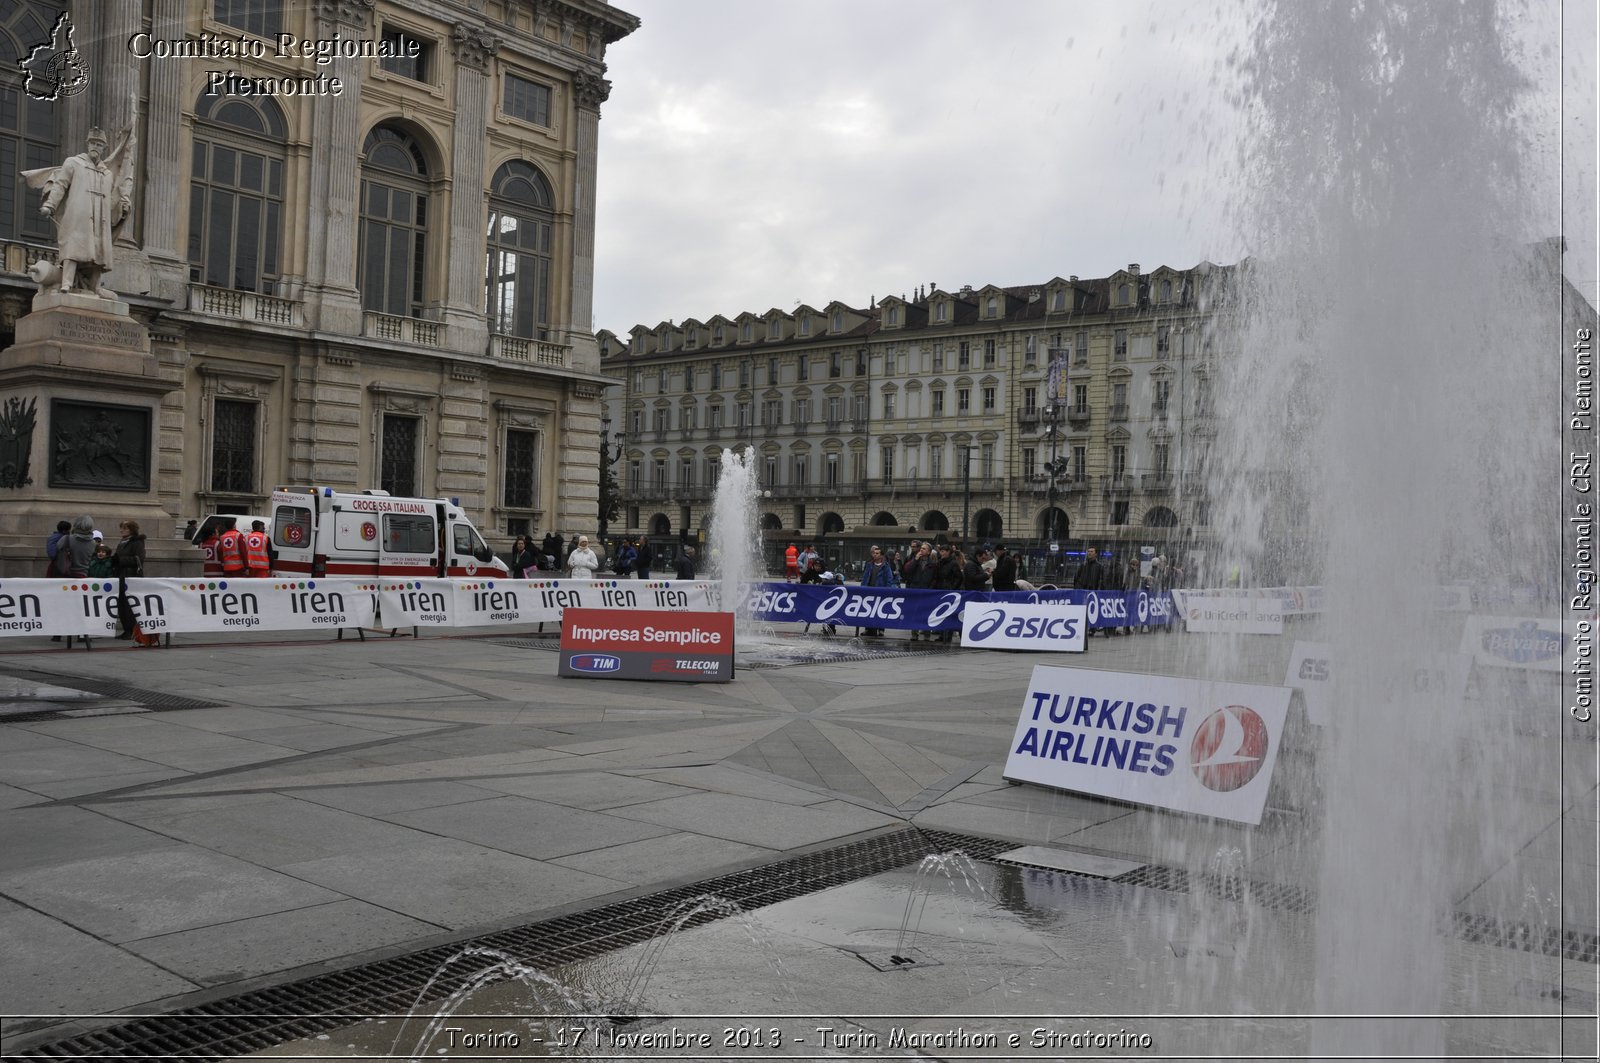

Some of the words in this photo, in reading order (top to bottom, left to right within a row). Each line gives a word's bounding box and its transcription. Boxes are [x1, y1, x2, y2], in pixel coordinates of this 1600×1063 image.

[353, 500, 377, 511] CROCE
[378, 502, 392, 513] SSA
[394, 504, 426, 514] ITALIANA
[0, 594, 41, 618] en
[200, 593, 259, 615] iren
[291, 592, 345, 614] iren
[400, 592, 445, 612] iren
[474, 591, 518, 611] iren
[541, 590, 581, 608] iren
[601, 589, 636, 608] iren
[655, 590, 688, 608] iren
[222, 616, 260, 628] energia
[312, 614, 346, 625] energia
[420, 613, 447, 624] energia
[490, 611, 519, 622] energia
[1257, 611, 1280, 622] anca
[572, 624, 640, 643] Impresa
[643, 626, 721, 646] Semplice
[1488, 635, 1560, 653] Bavaria
[592, 657, 615, 669] TIM
[675, 659, 719, 670] TELECOM
[1032, 691, 1188, 739] TURKISH
[1015, 727, 1179, 777] AIRLINES
